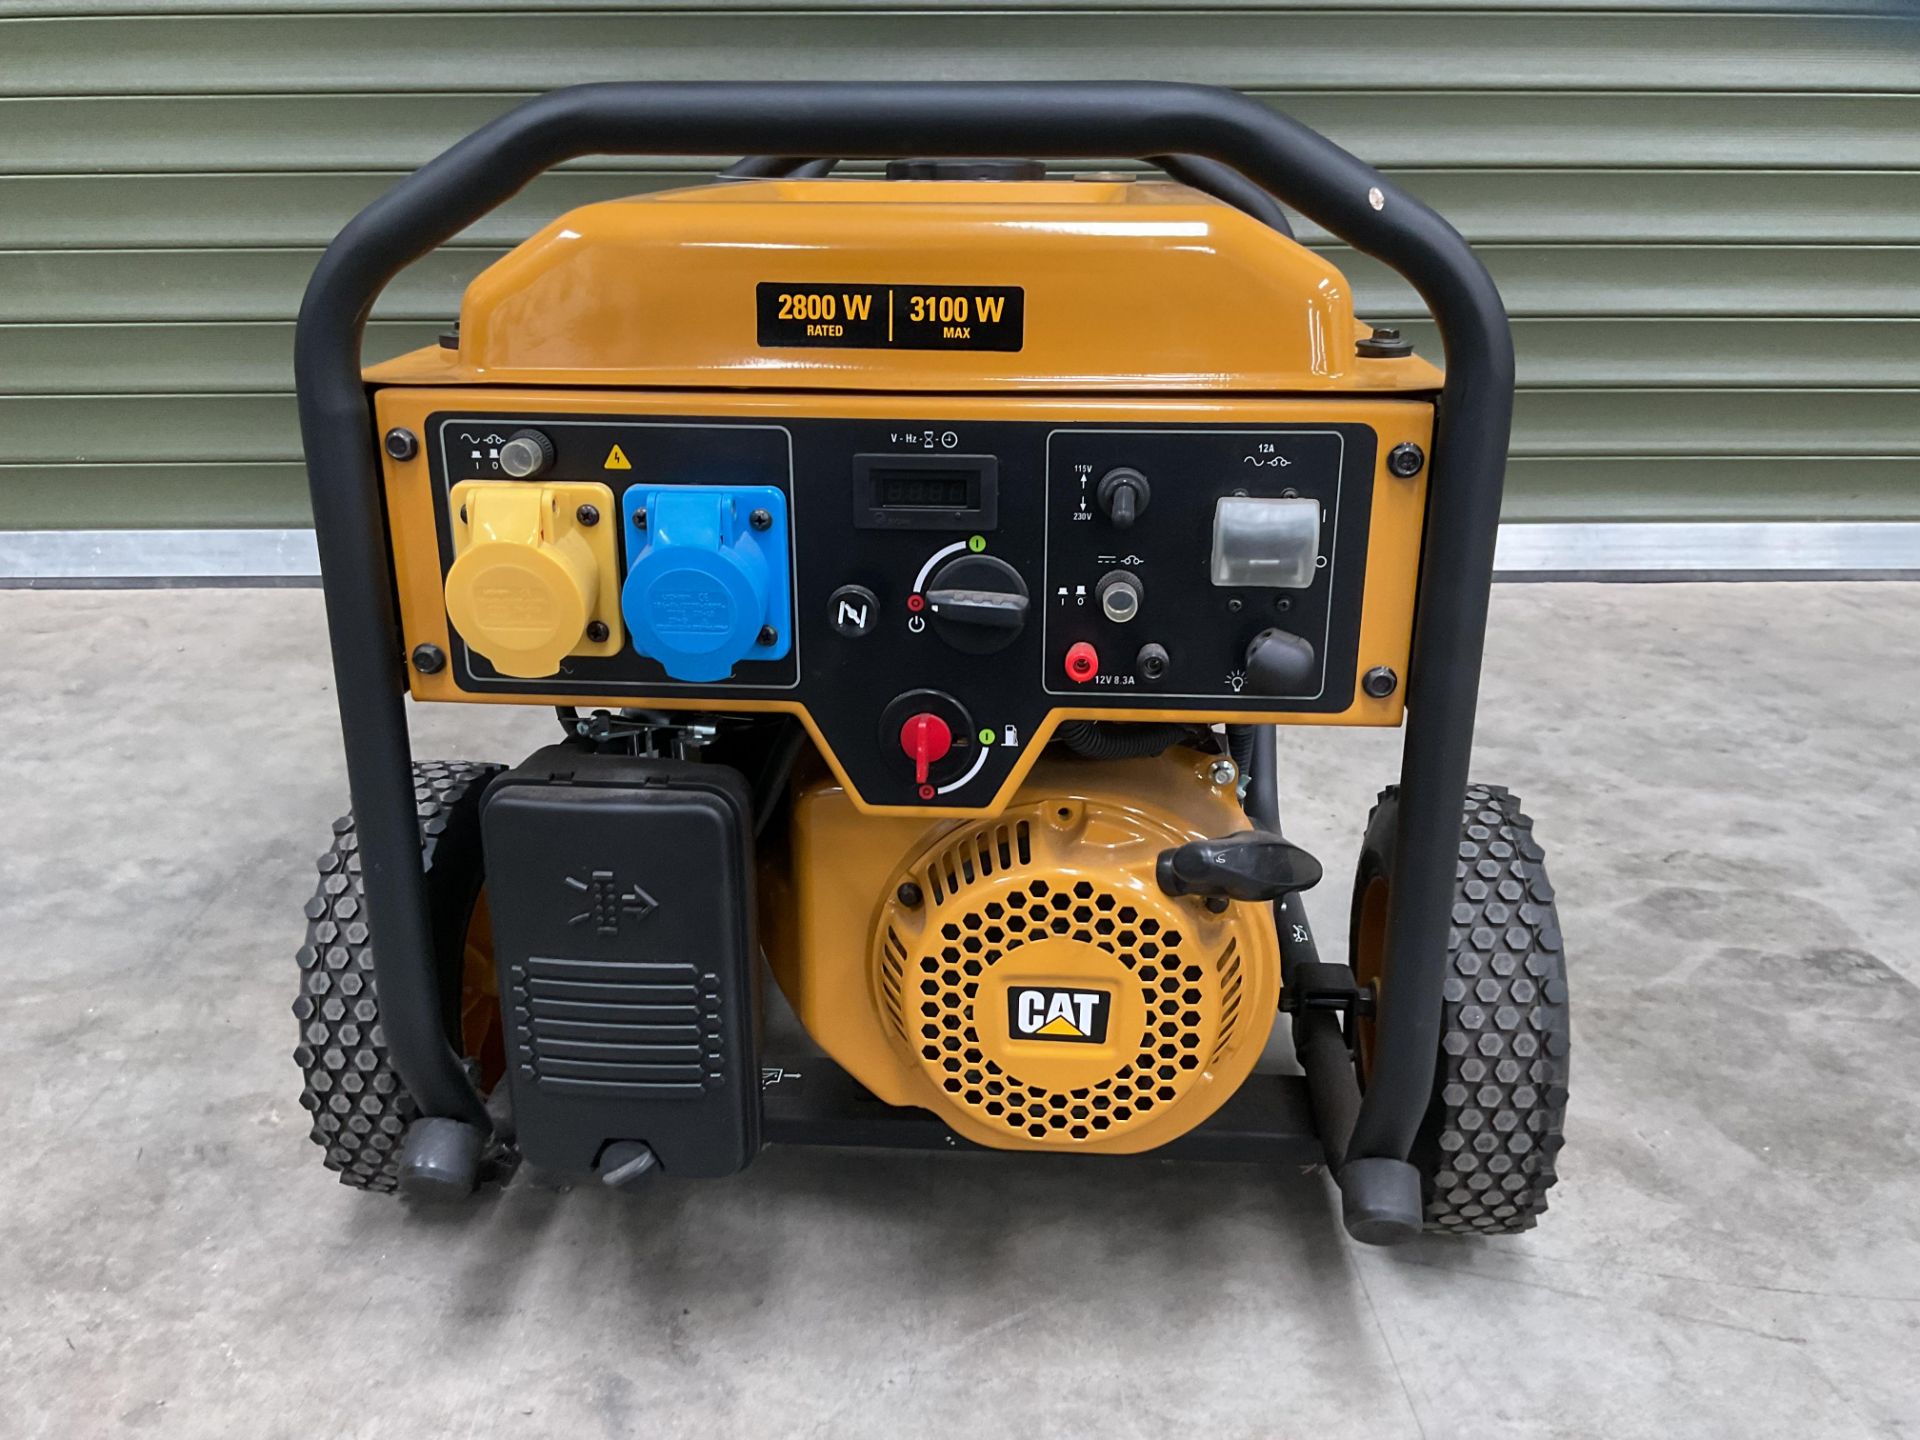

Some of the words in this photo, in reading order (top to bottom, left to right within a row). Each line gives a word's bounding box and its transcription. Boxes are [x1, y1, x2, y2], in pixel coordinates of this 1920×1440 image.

[777, 294, 836, 320] 2800
[843, 294, 872, 321] W
[909, 296, 968, 322] 3100
[976, 296, 1005, 323] W
[806, 324, 843, 337] RATED
[943, 326, 971, 339] MAX
[1258, 443, 1275, 453] 12A
[1074, 464, 1093, 473] 115V
[1073, 512, 1093, 521] 230V
[1094, 675, 1112, 685] 12V
[1113, 675, 1136, 685] 8.3A
[1018, 990, 1100, 1036] CAT
